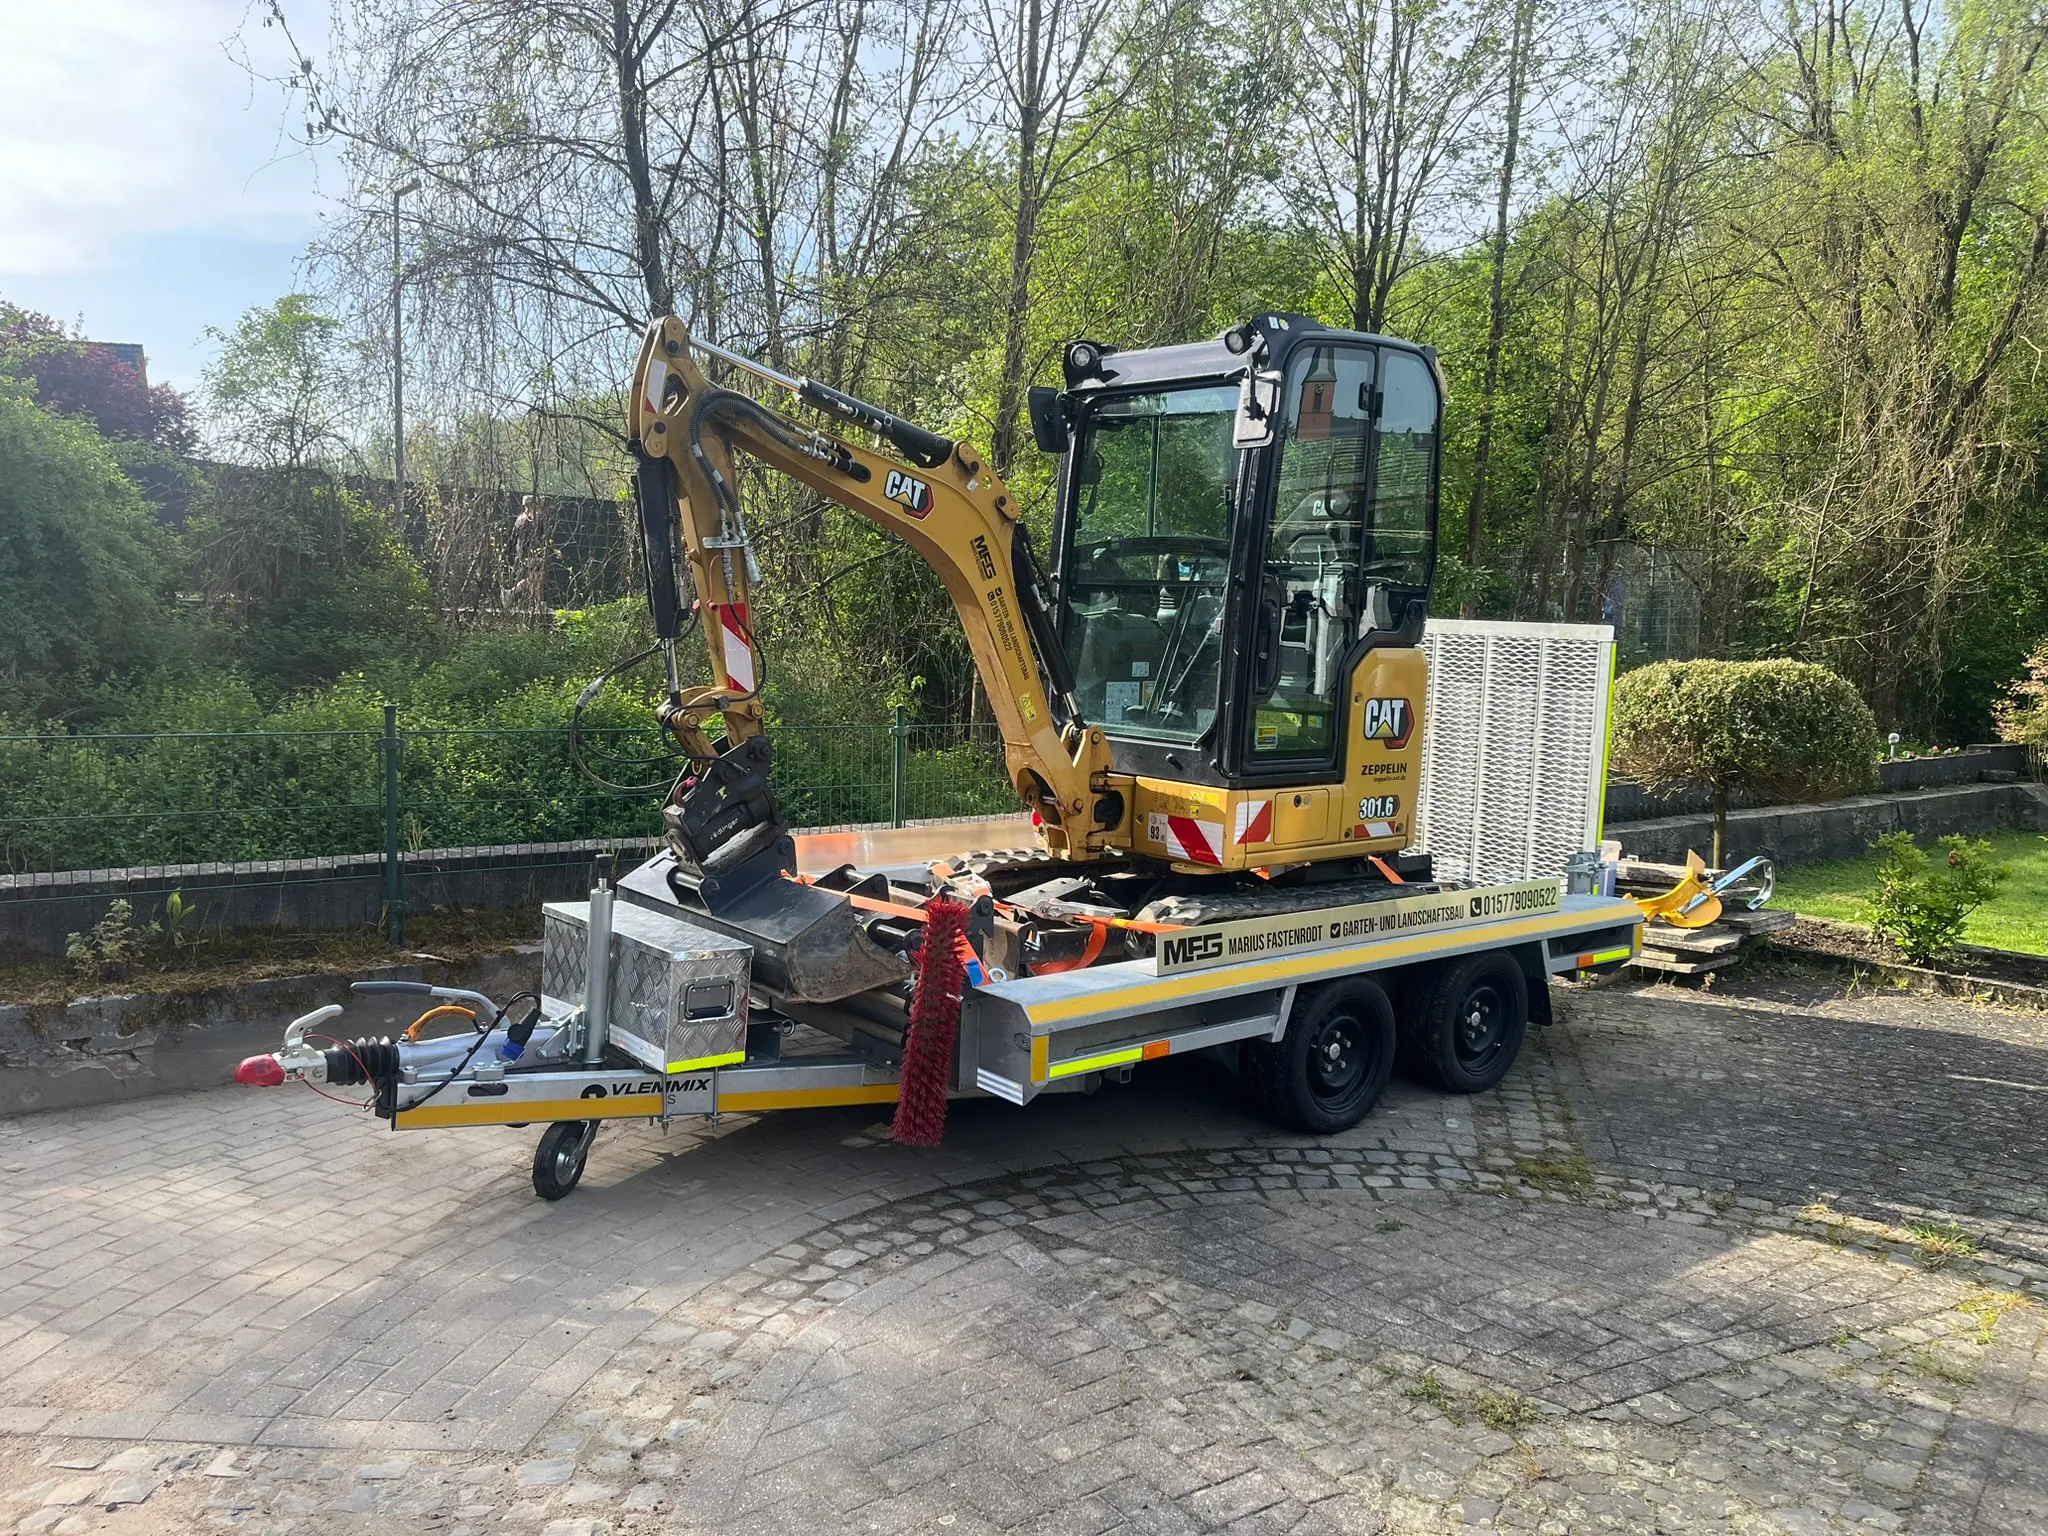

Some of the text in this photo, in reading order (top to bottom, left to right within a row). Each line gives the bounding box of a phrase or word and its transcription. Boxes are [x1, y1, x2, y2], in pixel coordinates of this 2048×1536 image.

[885, 470, 926, 509] CAT
[989, 600, 1012, 653] 015779090522
[998, 595, 1030, 681] GARTEN- UND LANDSCHAFTSBAU
[1364, 699, 1405, 739] CAT
[1361, 763, 1407, 776] ZEPPELIN
[1359, 797, 1394, 820] 301.6
[1150, 825, 1160, 840] 93
[1164, 886, 1557, 966] MFG MARIUS FASTENRODT GARTEN- UND LANDSCHAFTSBAU 015779090522
[612, 1079, 712, 1096] VLEMMIX
